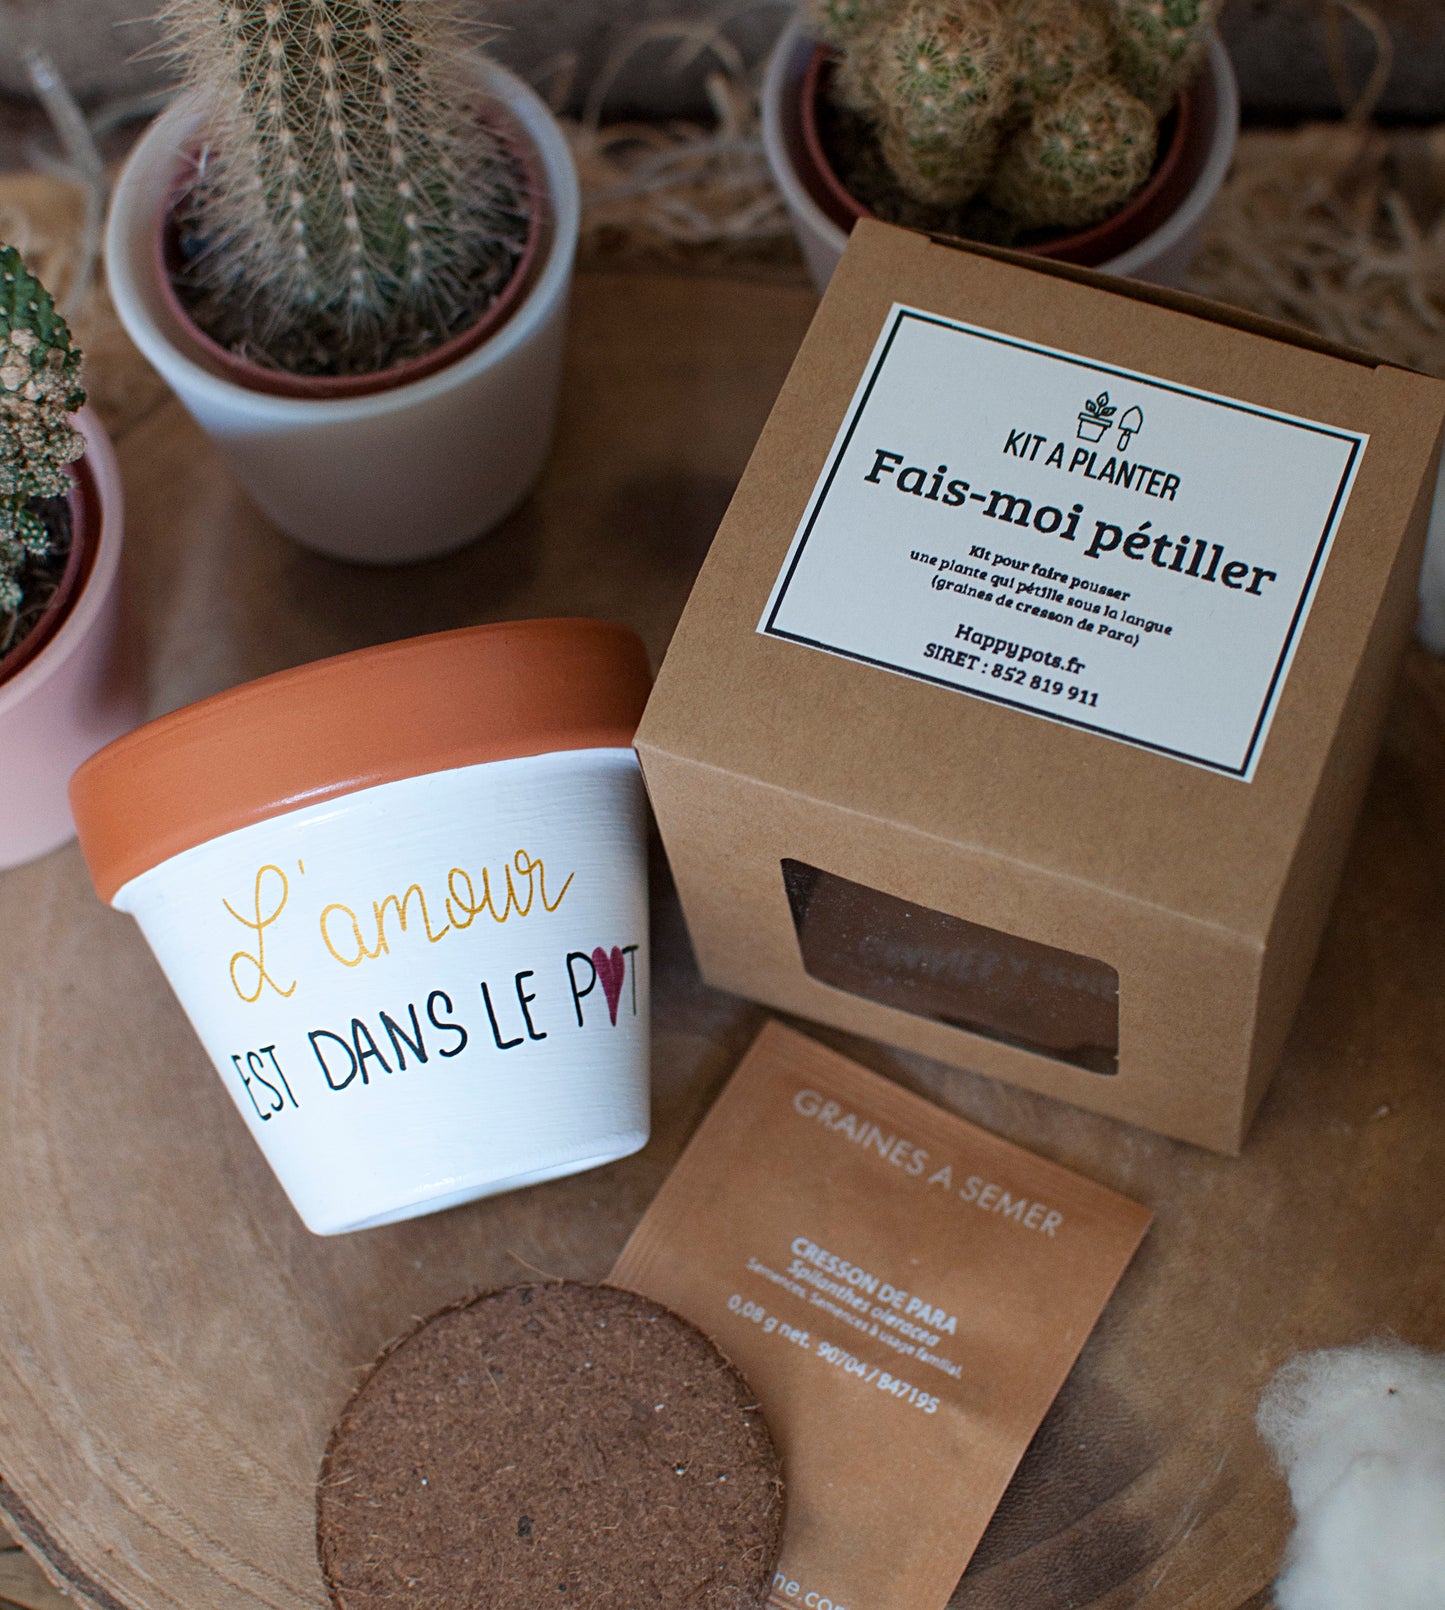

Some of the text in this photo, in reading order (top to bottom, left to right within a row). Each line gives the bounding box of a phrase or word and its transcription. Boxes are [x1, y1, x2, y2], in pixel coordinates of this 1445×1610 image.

[1003, 429, 1181, 501] KIT A PLANTER
[864, 449, 1277, 596] Fais-moi pétiller
[910, 550, 1173, 636] une plante qui pétille sous la langue
[931, 574, 1140, 648] (graines de cresson de Para)
[968, 545, 1131, 601] Kit pour faire pousser
[923, 643, 981, 670] SIRET
[991, 663, 1027, 686] 852
[1029, 675, 1064, 696] 819
[1067, 686, 1099, 707] 911
[954, 623, 1086, 675] Happypots.fr
[231, 1045, 299, 1121] EST
[308, 990, 468, 1091] DANS
[481, 970, 547, 1050] LE
[793, 1088, 1064, 1237] GRAINES A SEMER
[791, 1237, 957, 1335] CRESSON DE PARA
[728, 1294, 765, 1324] 0,08
[763, 1316, 779, 1333] g
[817, 1341, 868, 1377] 90704
[864, 1368, 879, 1383] /
